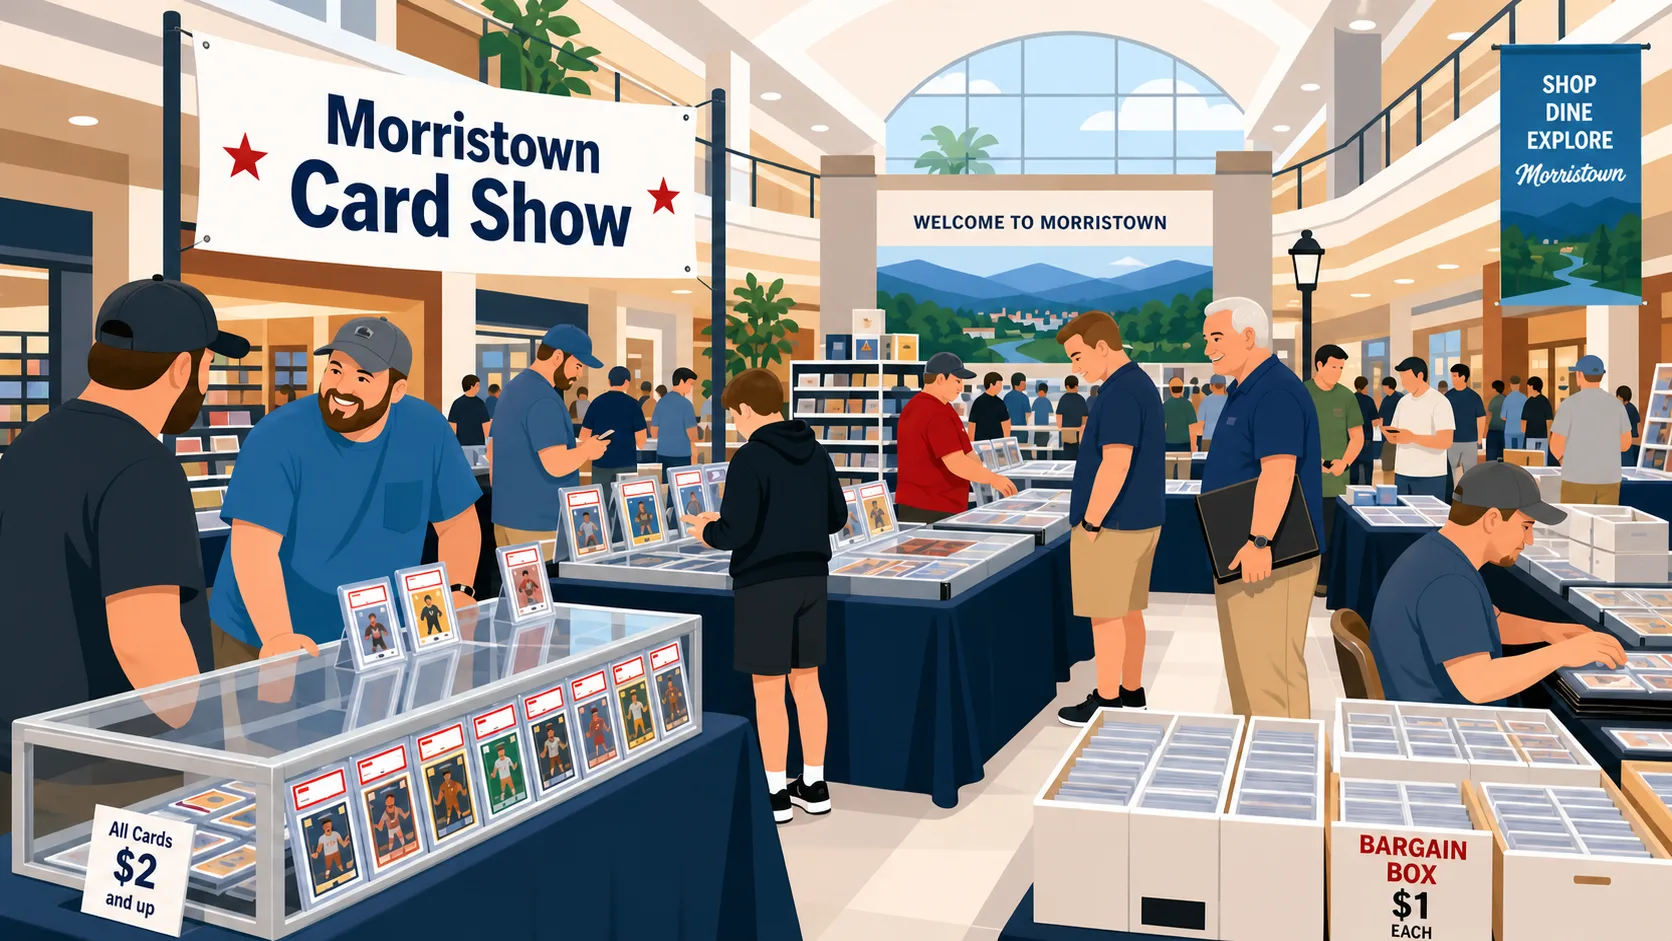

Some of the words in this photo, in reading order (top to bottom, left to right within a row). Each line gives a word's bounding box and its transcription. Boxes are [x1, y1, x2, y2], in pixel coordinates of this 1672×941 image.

[1543, 74, 1597, 94] SHOP
[1546, 103, 1593, 122] DINE
[327, 93, 600, 174] Morristown
[1527, 130, 1613, 150] EXPLORE
[1515, 162, 1627, 187] Morristown
[291, 158, 450, 239] Card
[470, 177, 632, 247] Show
[913, 215, 1005, 230] WELCOME
[1010, 215, 1034, 230] TO
[1040, 215, 1167, 230] MORRISTOWN
[108, 820, 129, 839] All
[132, 825, 173, 849] Cards
[1360, 834, 1467, 860] BARGAIN
[113, 846, 157, 890] $2
[1387, 861, 1437, 885] BOX
[105, 892, 133, 911] and
[136, 900, 155, 919] up
[1392, 887, 1428, 922] $1
[1391, 923, 1432, 940] EACH
